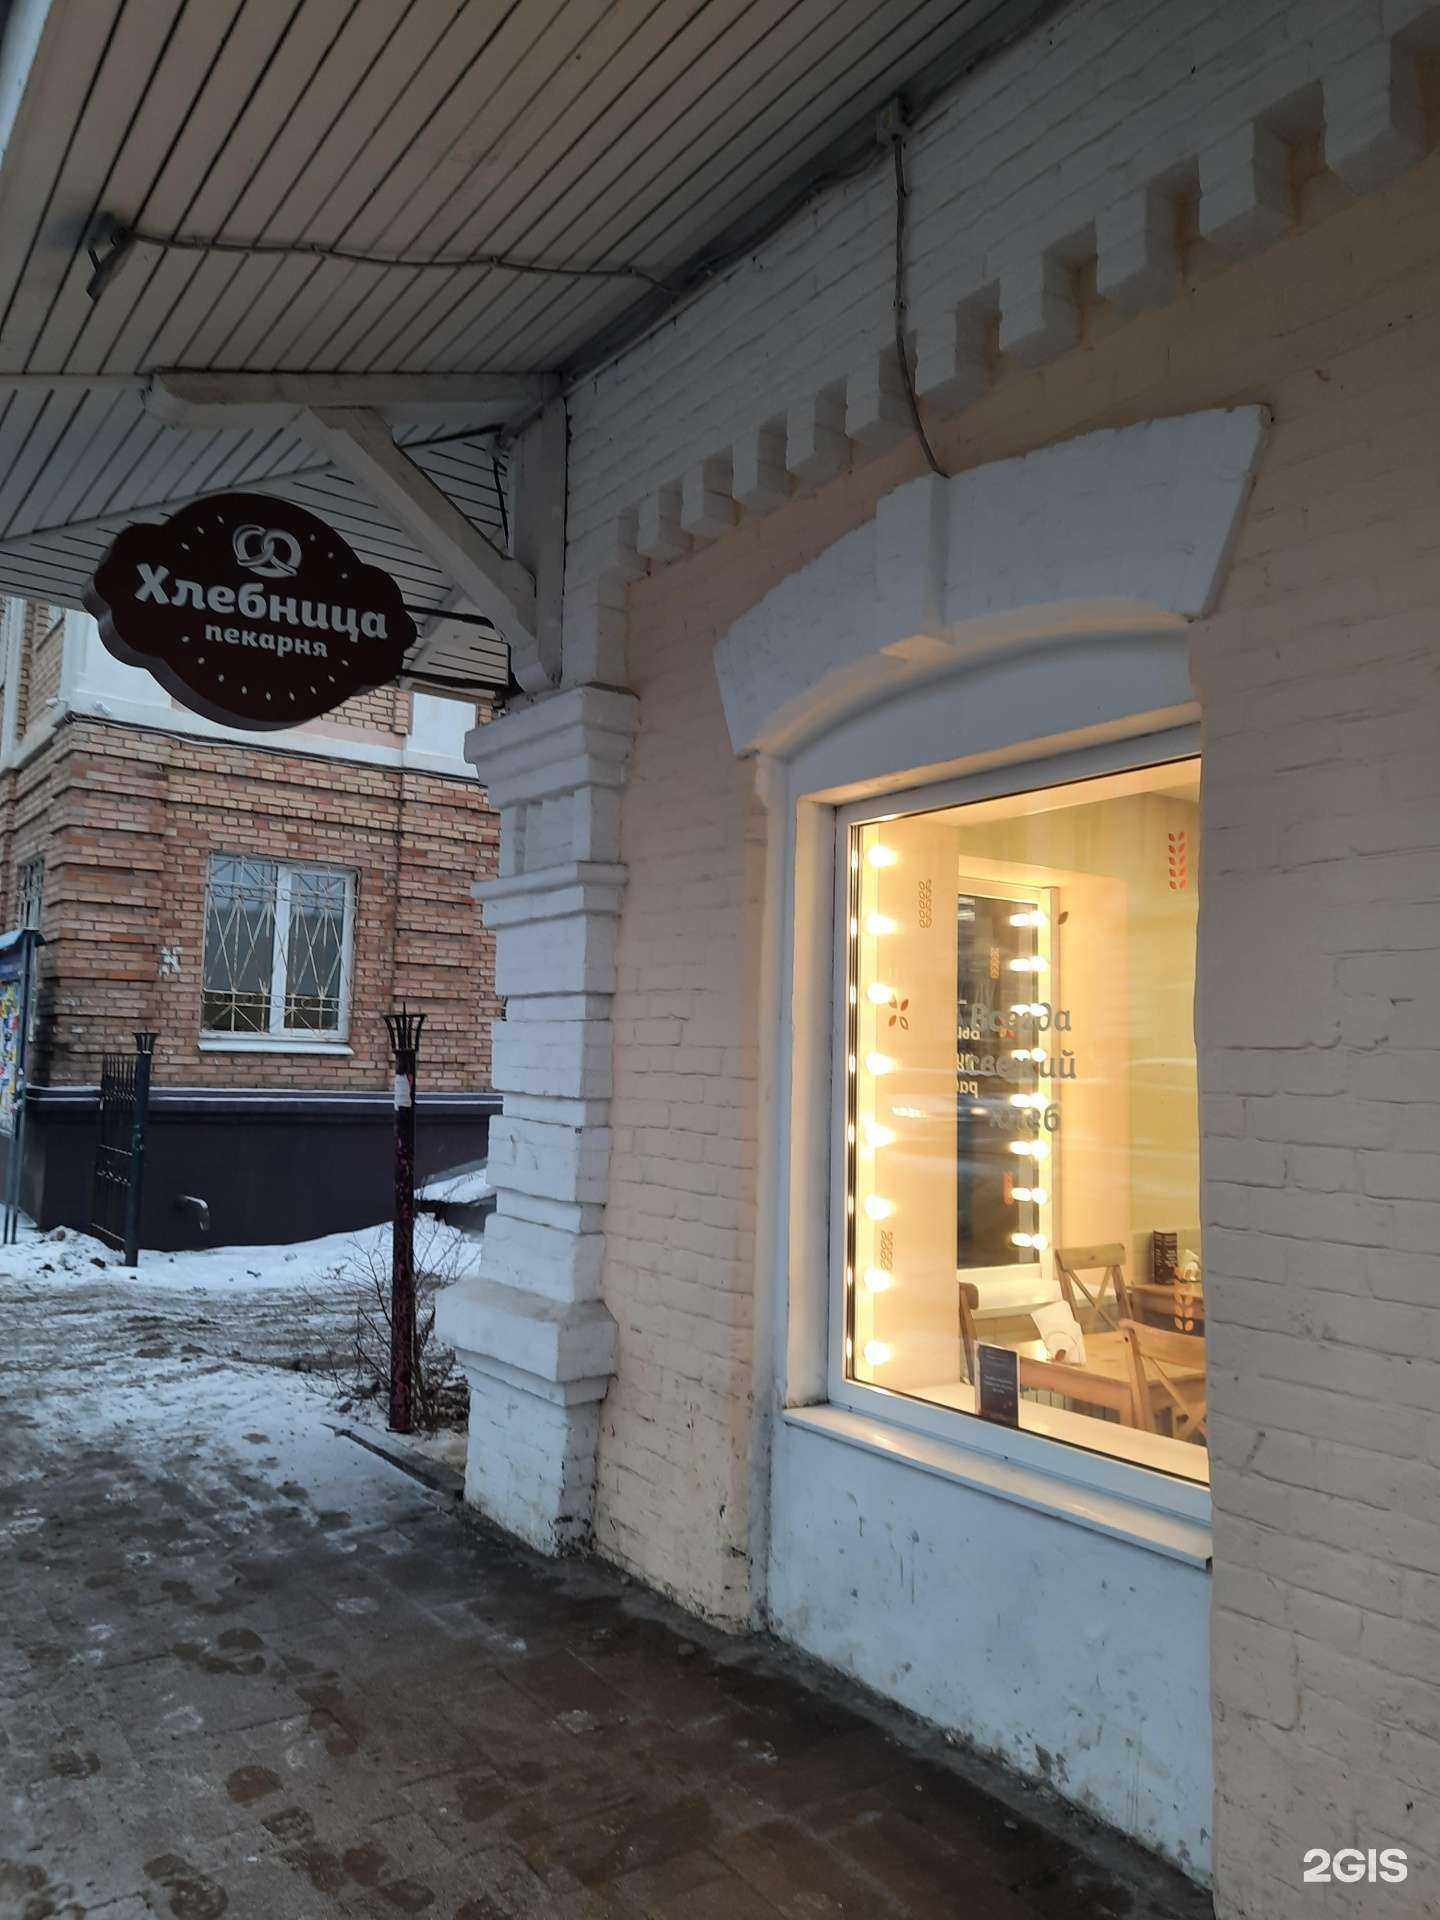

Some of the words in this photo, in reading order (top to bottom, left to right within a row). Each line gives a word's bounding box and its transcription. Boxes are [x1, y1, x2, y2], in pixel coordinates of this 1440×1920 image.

[134, 562, 388, 643] Хлебница
[204, 623, 328, 658] пекарня
[967, 1048, 1077, 1079] свеий
